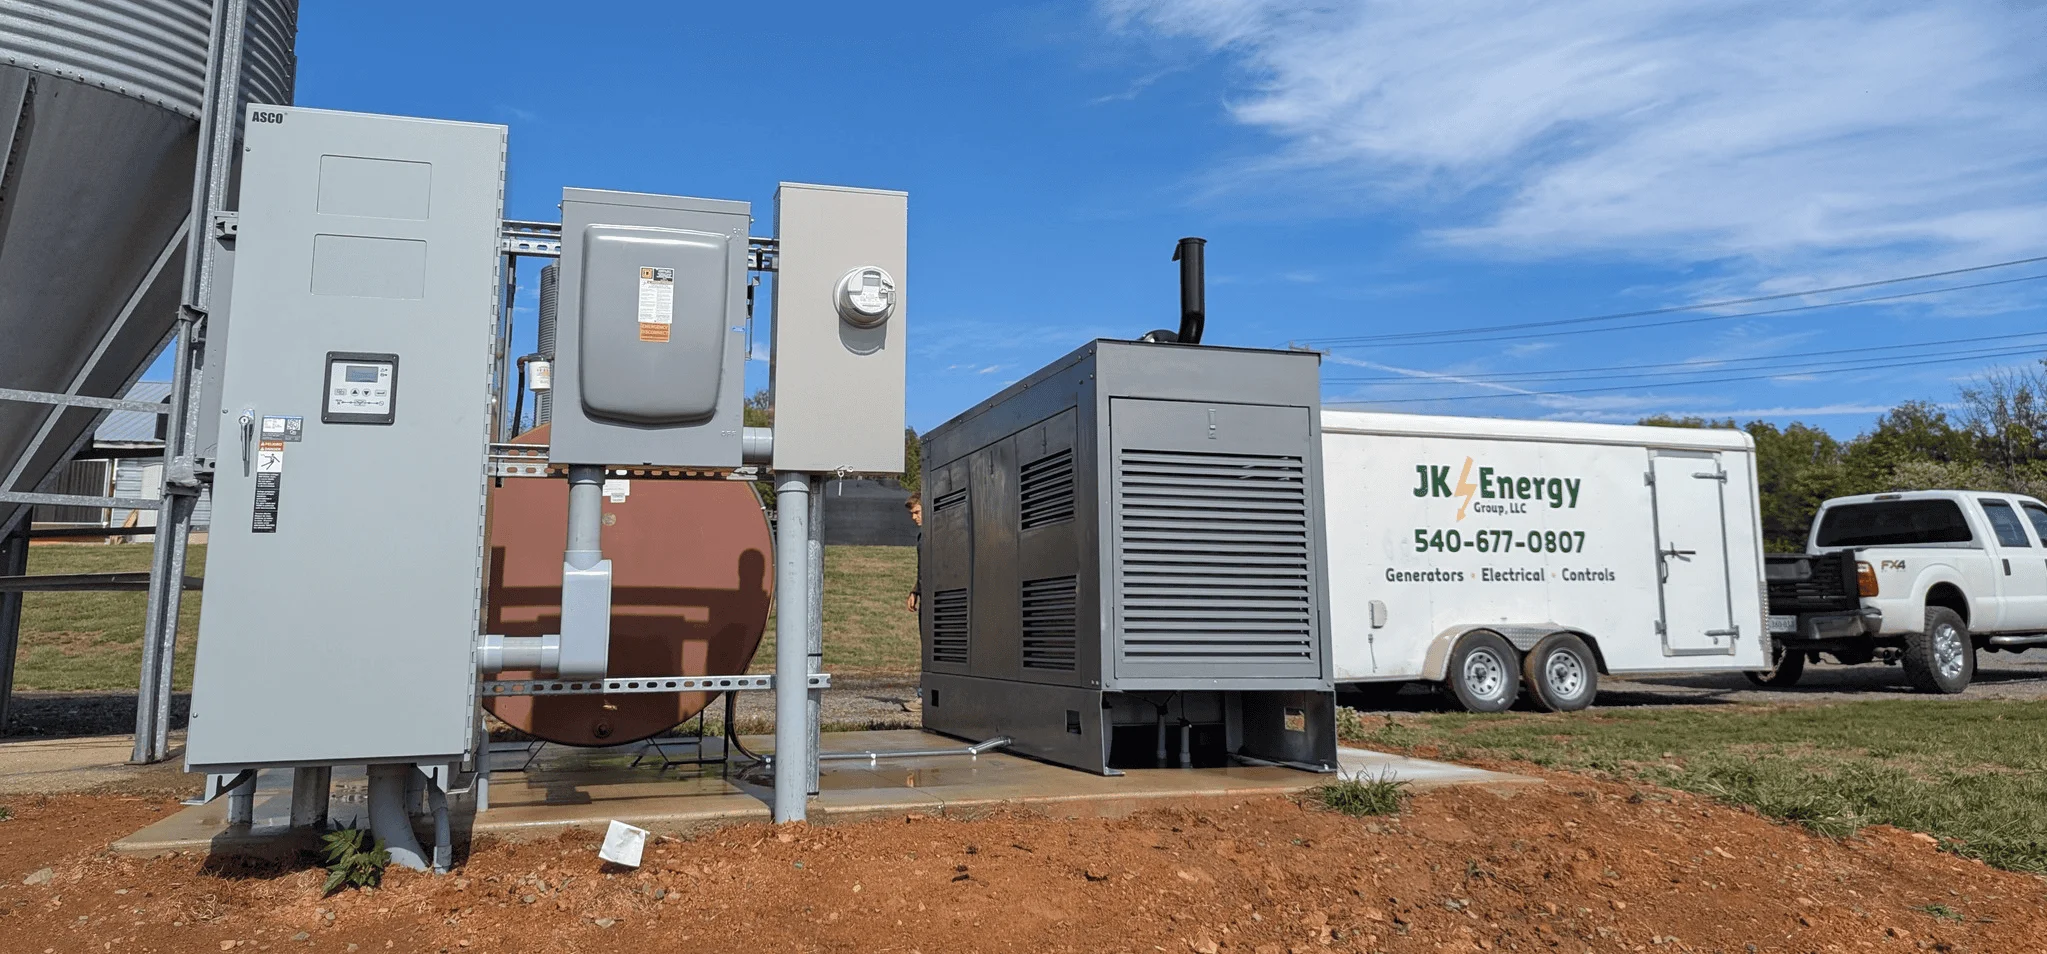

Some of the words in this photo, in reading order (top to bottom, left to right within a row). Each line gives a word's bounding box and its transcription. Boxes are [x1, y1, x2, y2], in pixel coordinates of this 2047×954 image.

[252, 111, 284, 124] ASCO
[1413, 465, 1452, 498] JK
[1479, 467, 1581, 508] Energy
[1474, 502, 1508, 516] Group,
[1510, 502, 1527, 514] LLC
[1414, 529, 1586, 553] 540-677-0807
[1881, 560, 1906, 570] FX4
[1385, 568, 1464, 582] Generators
[1481, 568, 1545, 582] Electrical
[1562, 568, 1616, 582] Controls
